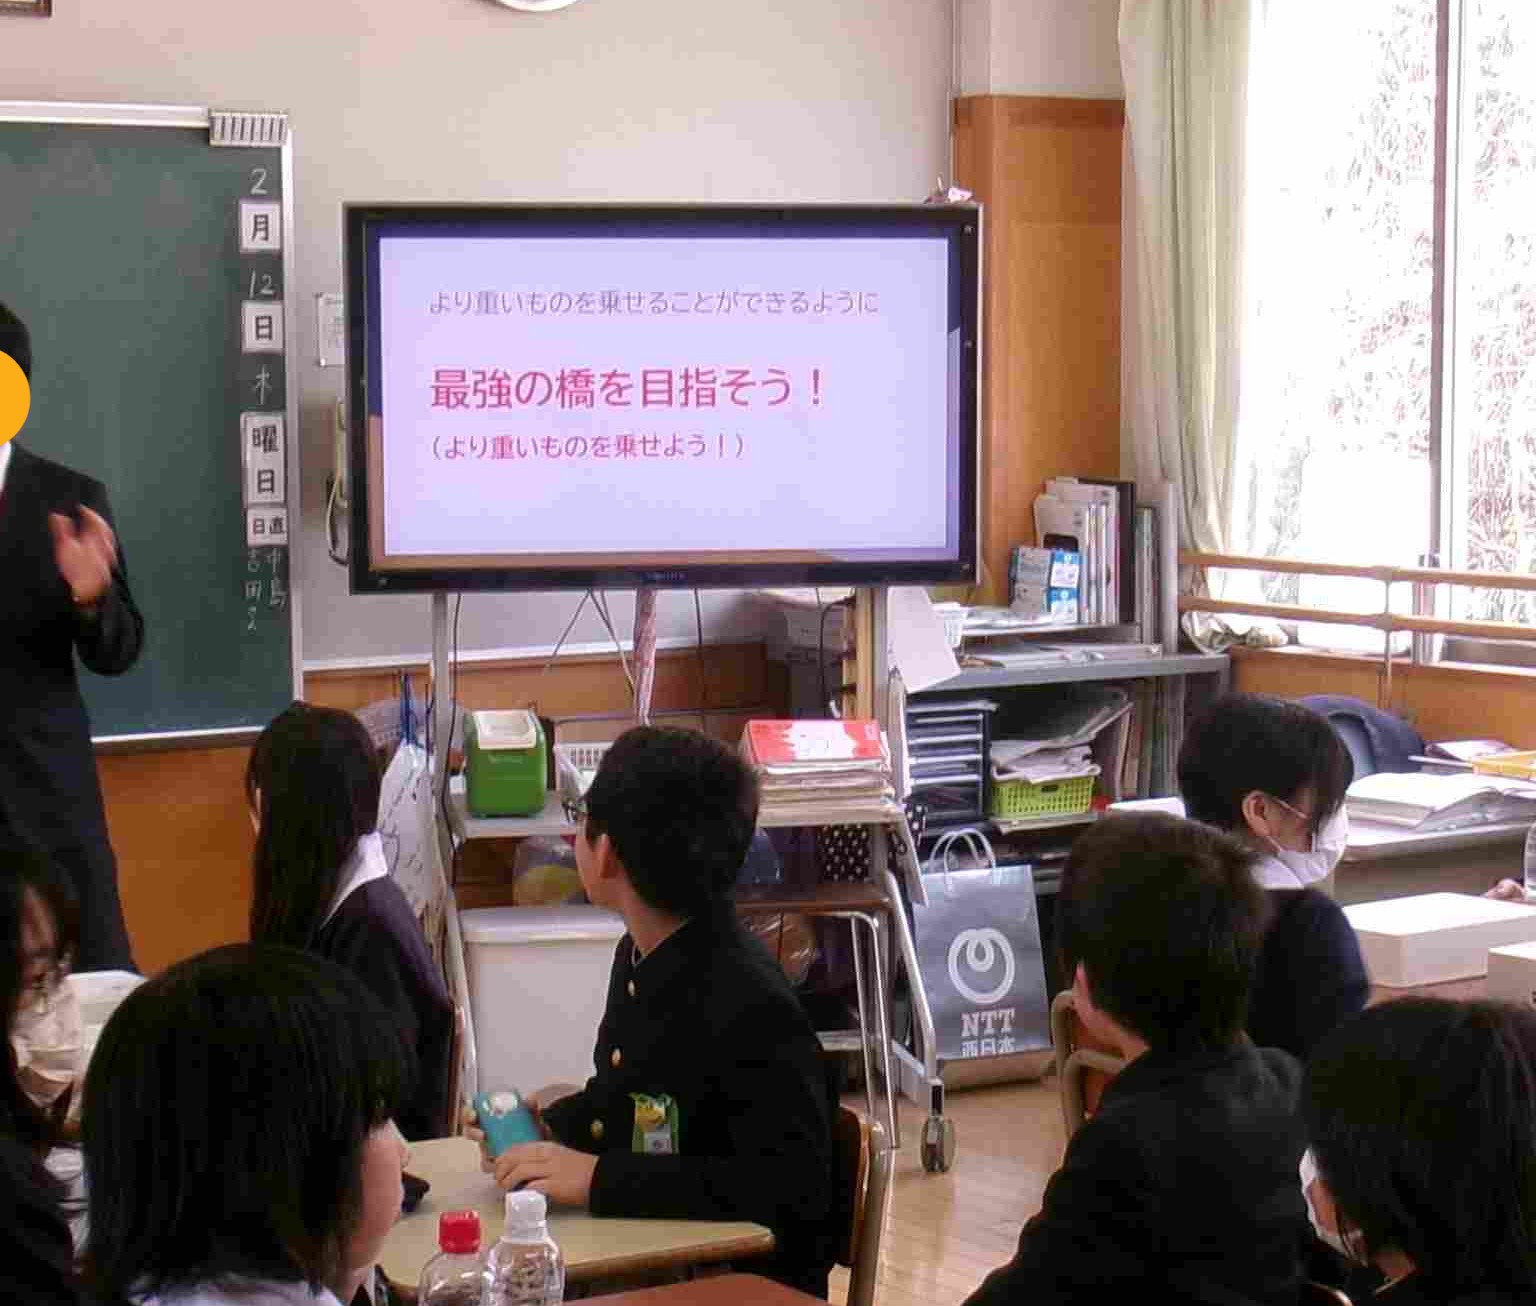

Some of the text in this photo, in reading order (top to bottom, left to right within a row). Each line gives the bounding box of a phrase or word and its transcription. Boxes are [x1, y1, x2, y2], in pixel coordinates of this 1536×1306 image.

[428, 290, 880, 316] より重いものを乗せることができるように
[430, 367, 824, 410] 最強の橋を目指そう！
[961, 1008, 1015, 1036] NTT
[961, 1038, 1015, 1058] 西日本
